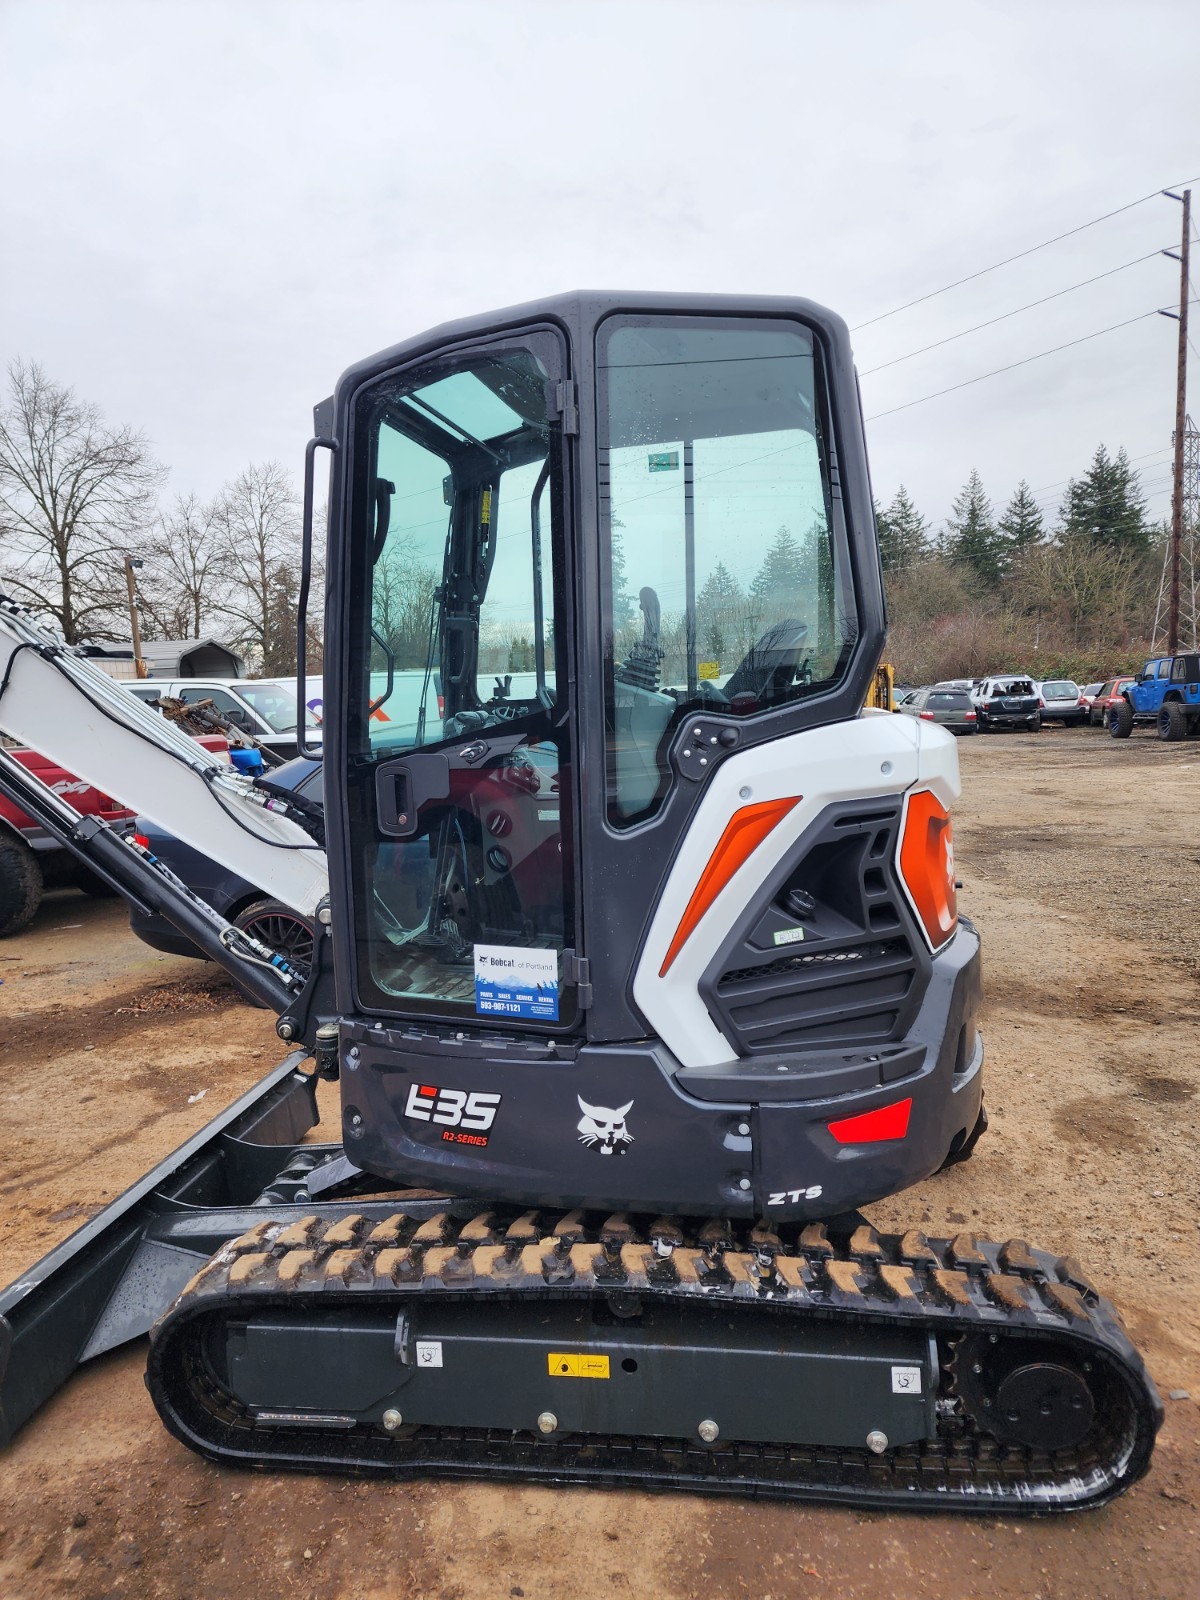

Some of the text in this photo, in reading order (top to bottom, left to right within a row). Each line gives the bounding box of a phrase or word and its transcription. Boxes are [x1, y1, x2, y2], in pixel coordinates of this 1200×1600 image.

[490, 957, 515, 967] Bobcat
[404, 1083, 501, 1131] E35
[443, 1131, 488, 1147] R2-SERIES
[767, 1185, 823, 1206] ZTS
